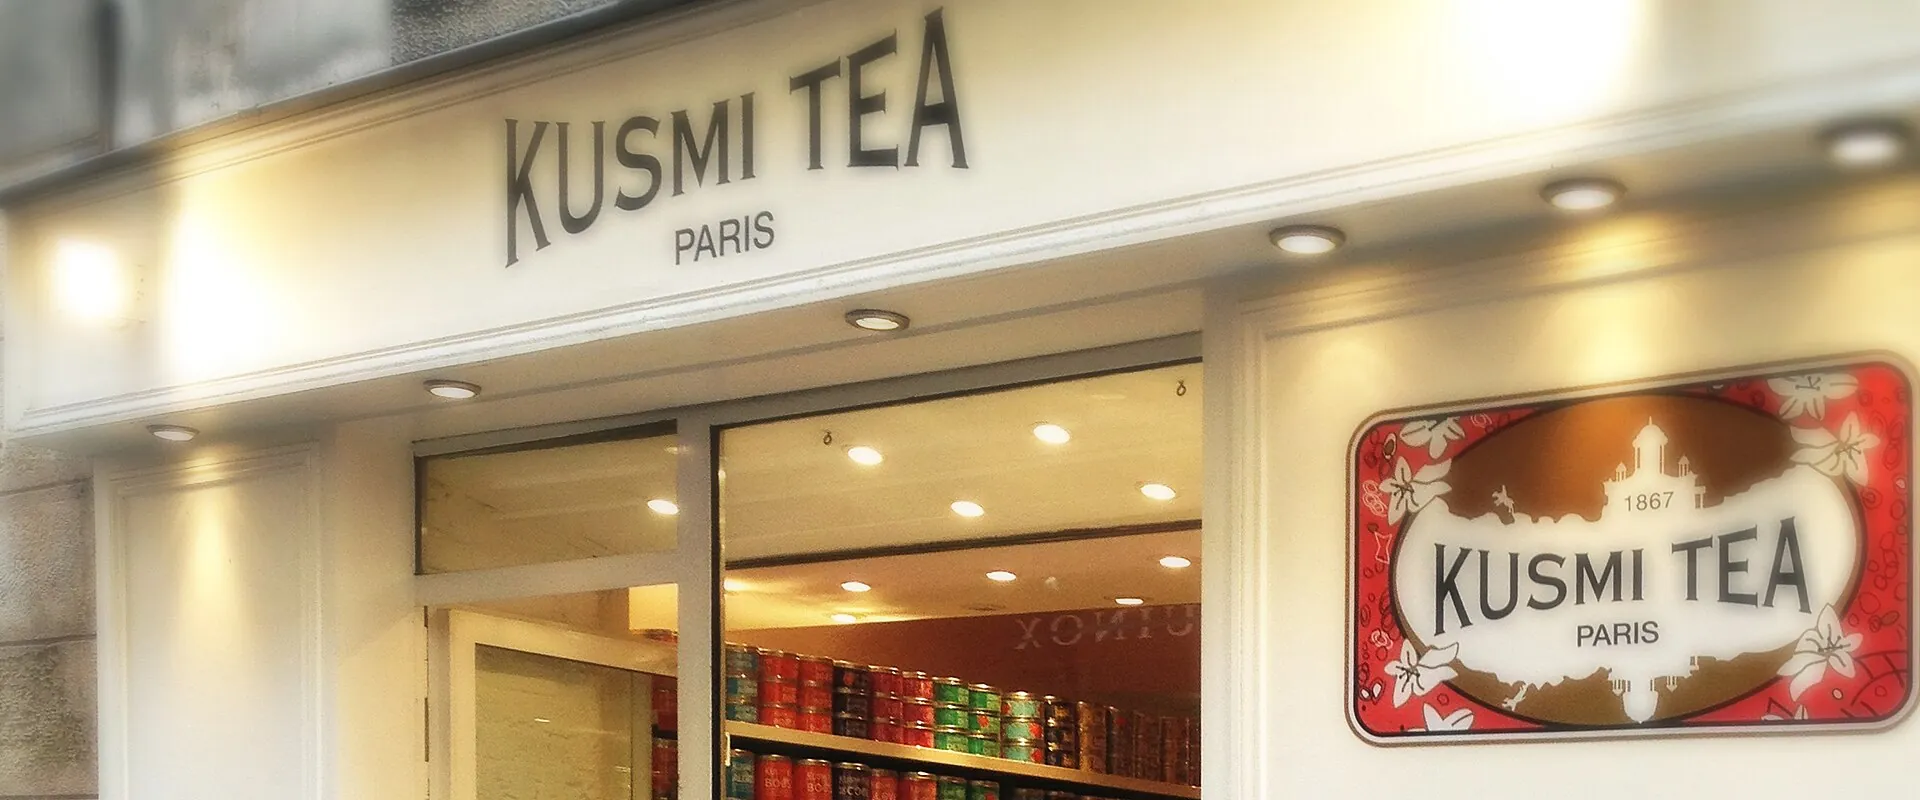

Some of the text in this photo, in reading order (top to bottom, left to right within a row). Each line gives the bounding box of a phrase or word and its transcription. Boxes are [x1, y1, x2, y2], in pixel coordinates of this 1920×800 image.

[505, 6, 968, 268] KUSMI TEA
[675, 211, 775, 265] PARIS
[1624, 491, 1673, 512] 1867
[1434, 517, 1812, 636] KUSMI TEA
[1576, 620, 1659, 647] PARIS
